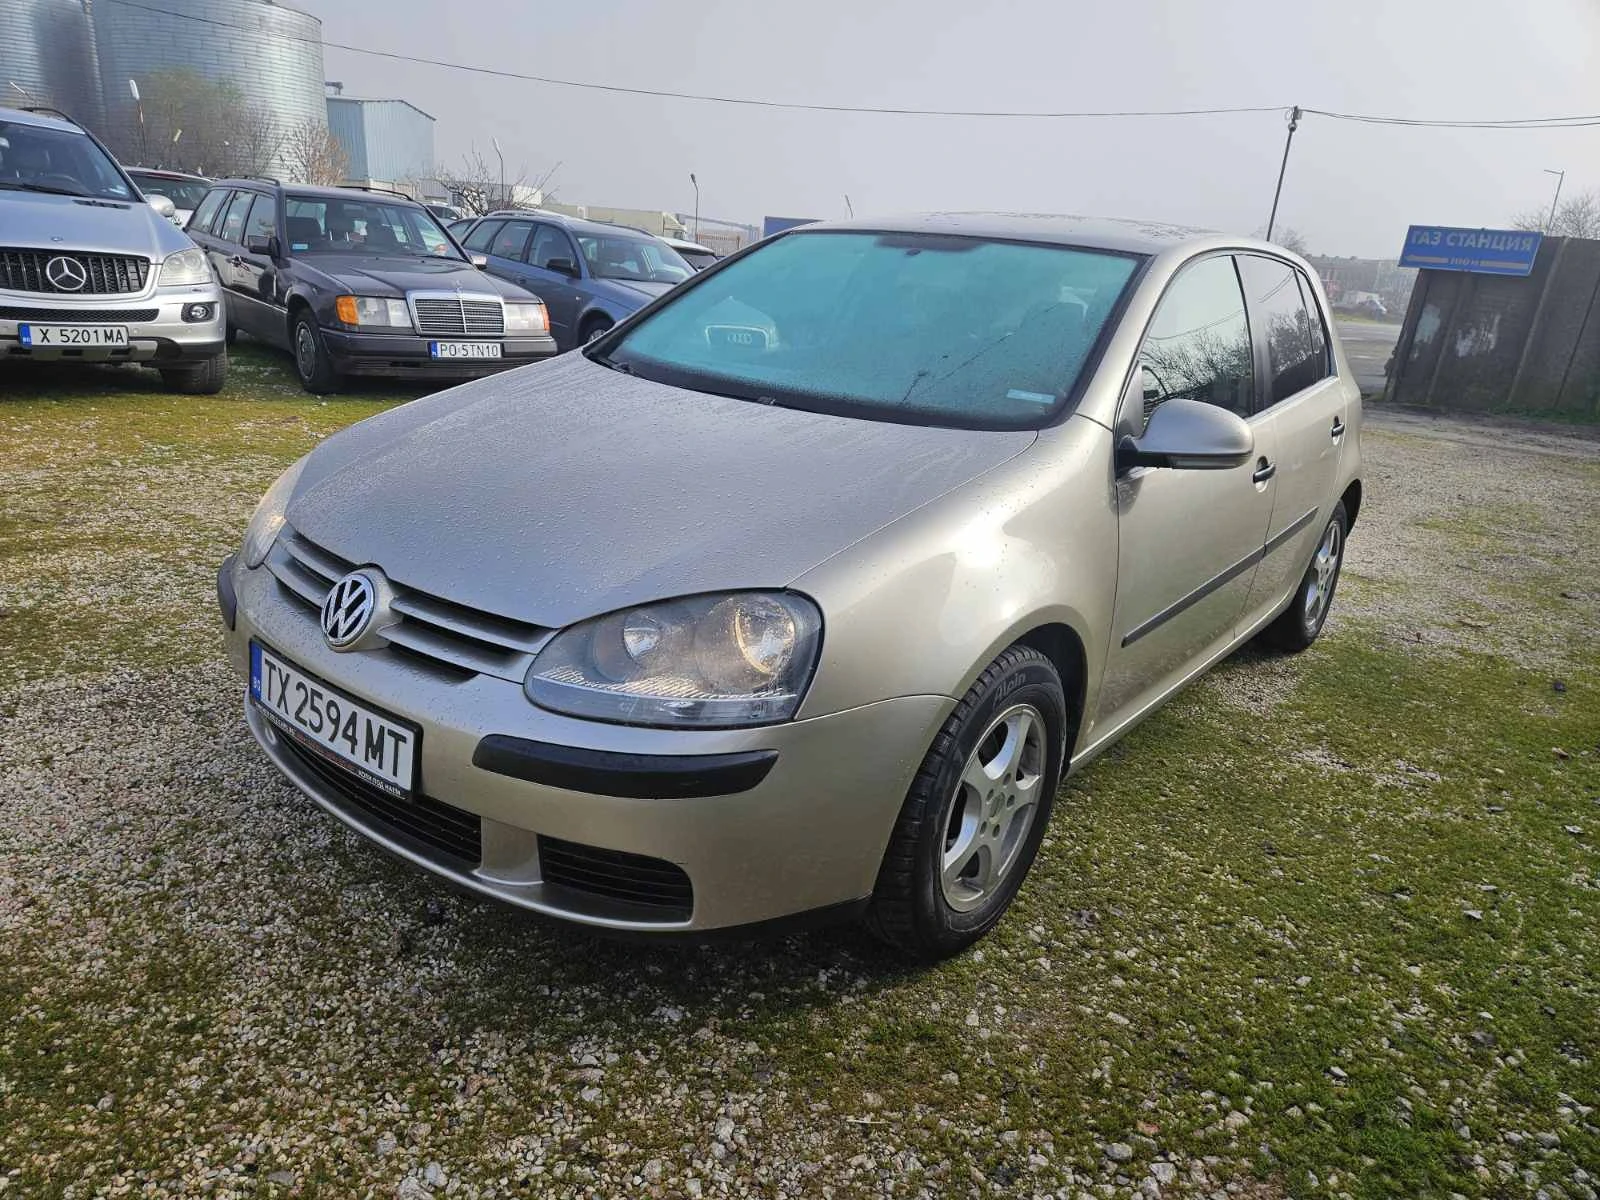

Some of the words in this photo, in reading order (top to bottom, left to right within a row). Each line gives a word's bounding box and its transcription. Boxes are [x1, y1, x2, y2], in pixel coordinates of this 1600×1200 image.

[1411, 230, 1442, 246] ГАЗ
[1446, 233, 1534, 252] СТАНЦИЯ
[39, 328, 50, 343] X
[60, 328, 99, 343] 5201
[103, 329, 124, 343] MA
[440, 344, 457, 357] PO
[462, 344, 499, 357] 5TN10
[264, 658, 290, 716] TX
[294, 681, 358, 756] 2594
[364, 718, 407, 778] MT
